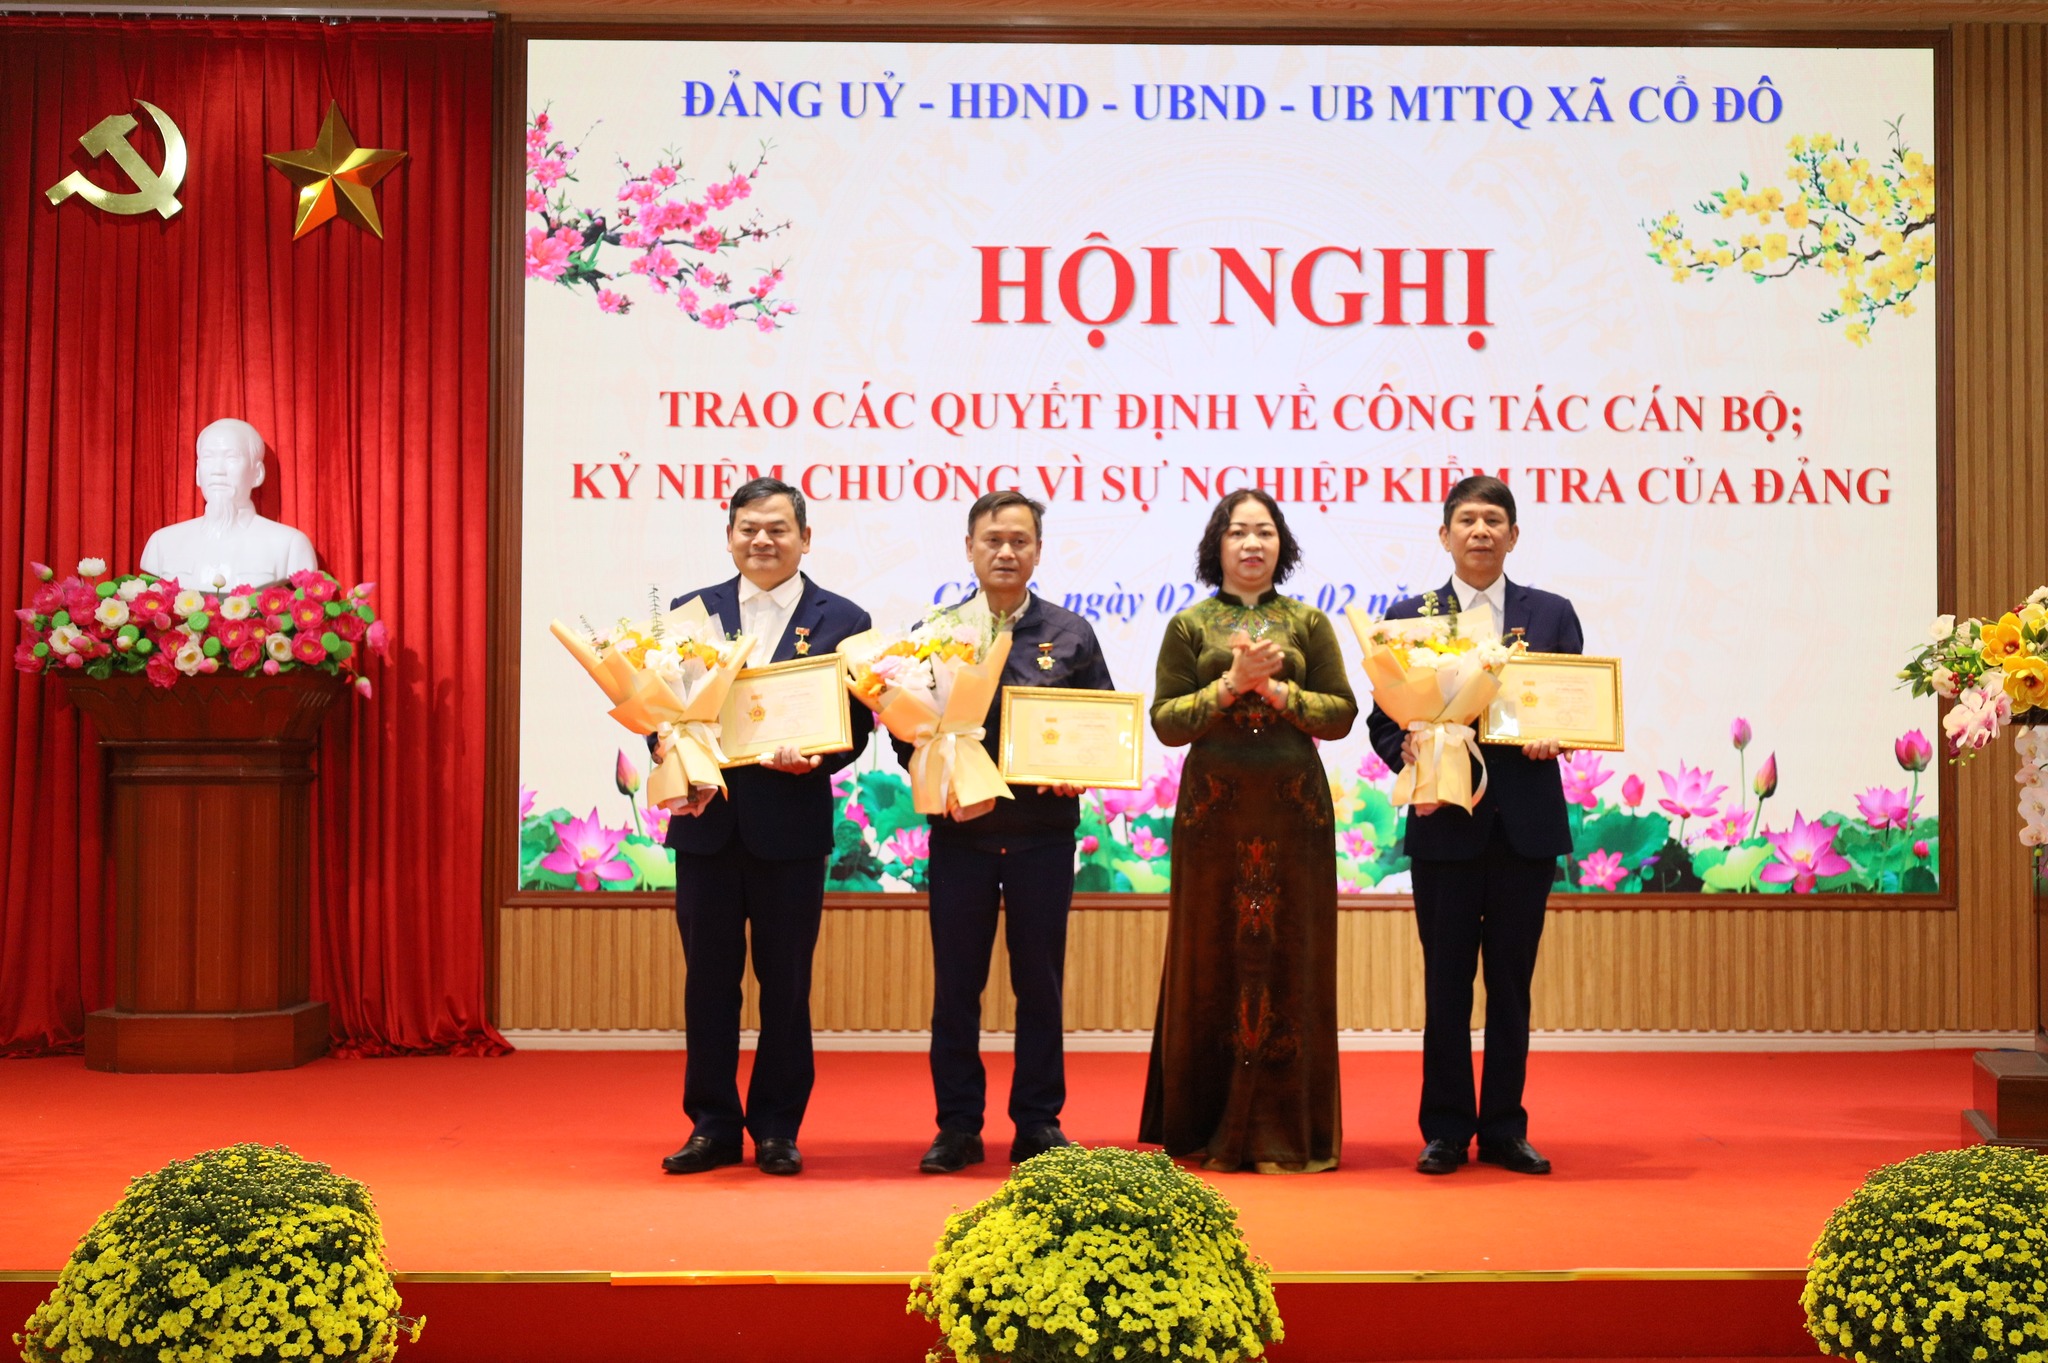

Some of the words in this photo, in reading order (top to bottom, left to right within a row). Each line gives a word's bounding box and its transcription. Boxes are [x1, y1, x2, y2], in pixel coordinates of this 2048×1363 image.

[681, 68, 823, 119] ĐẢNG
[839, 70, 906, 119] UỶ
[947, 82, 1089, 121] HĐND
[1131, 83, 1267, 122] UBND
[1309, 84, 1375, 122] UB
[1388, 84, 1534, 130] MTTQ
[1546, 76, 1615, 123] XÃ
[1628, 74, 1701, 124] CỔ
[1713, 74, 1784, 124] ĐÔ
[971, 231, 1178, 349] HỘI
[1209, 245, 1496, 351] NGHỊ
[659, 390, 799, 430] TRAO
[812, 381, 916, 430] CÁC
[930, 382, 1102, 438] QUYẾT
[1114, 393, 1239, 441] ĐỊNH
[1253, 383, 1318, 431] VỀ
[1332, 382, 1476, 432] CÔNG
[1489, 383, 1590, 432] TÁC
[1603, 383, 1705, 433] CÁN
[1721, 390, 1804, 443] BỘ;
[572, 451, 641, 500] KỶ
[800, 457, 1020, 501] CHƯƠNG
[1036, 453, 1086, 502] VÌ
[1101, 459, 1169, 513] SỰ
[1180, 461, 1369, 514] NGHIỆP
[1383, 455, 1512, 503] KIỂ
[1525, 467, 1625, 505] TRA
[1637, 456, 1740, 505] CỦA
[1752, 456, 1891, 505] ĐẢNG
[1062, 581, 1145, 623] ngày
[1156, 582, 1197, 614] 02
[1317, 583, 1357, 615] 02
